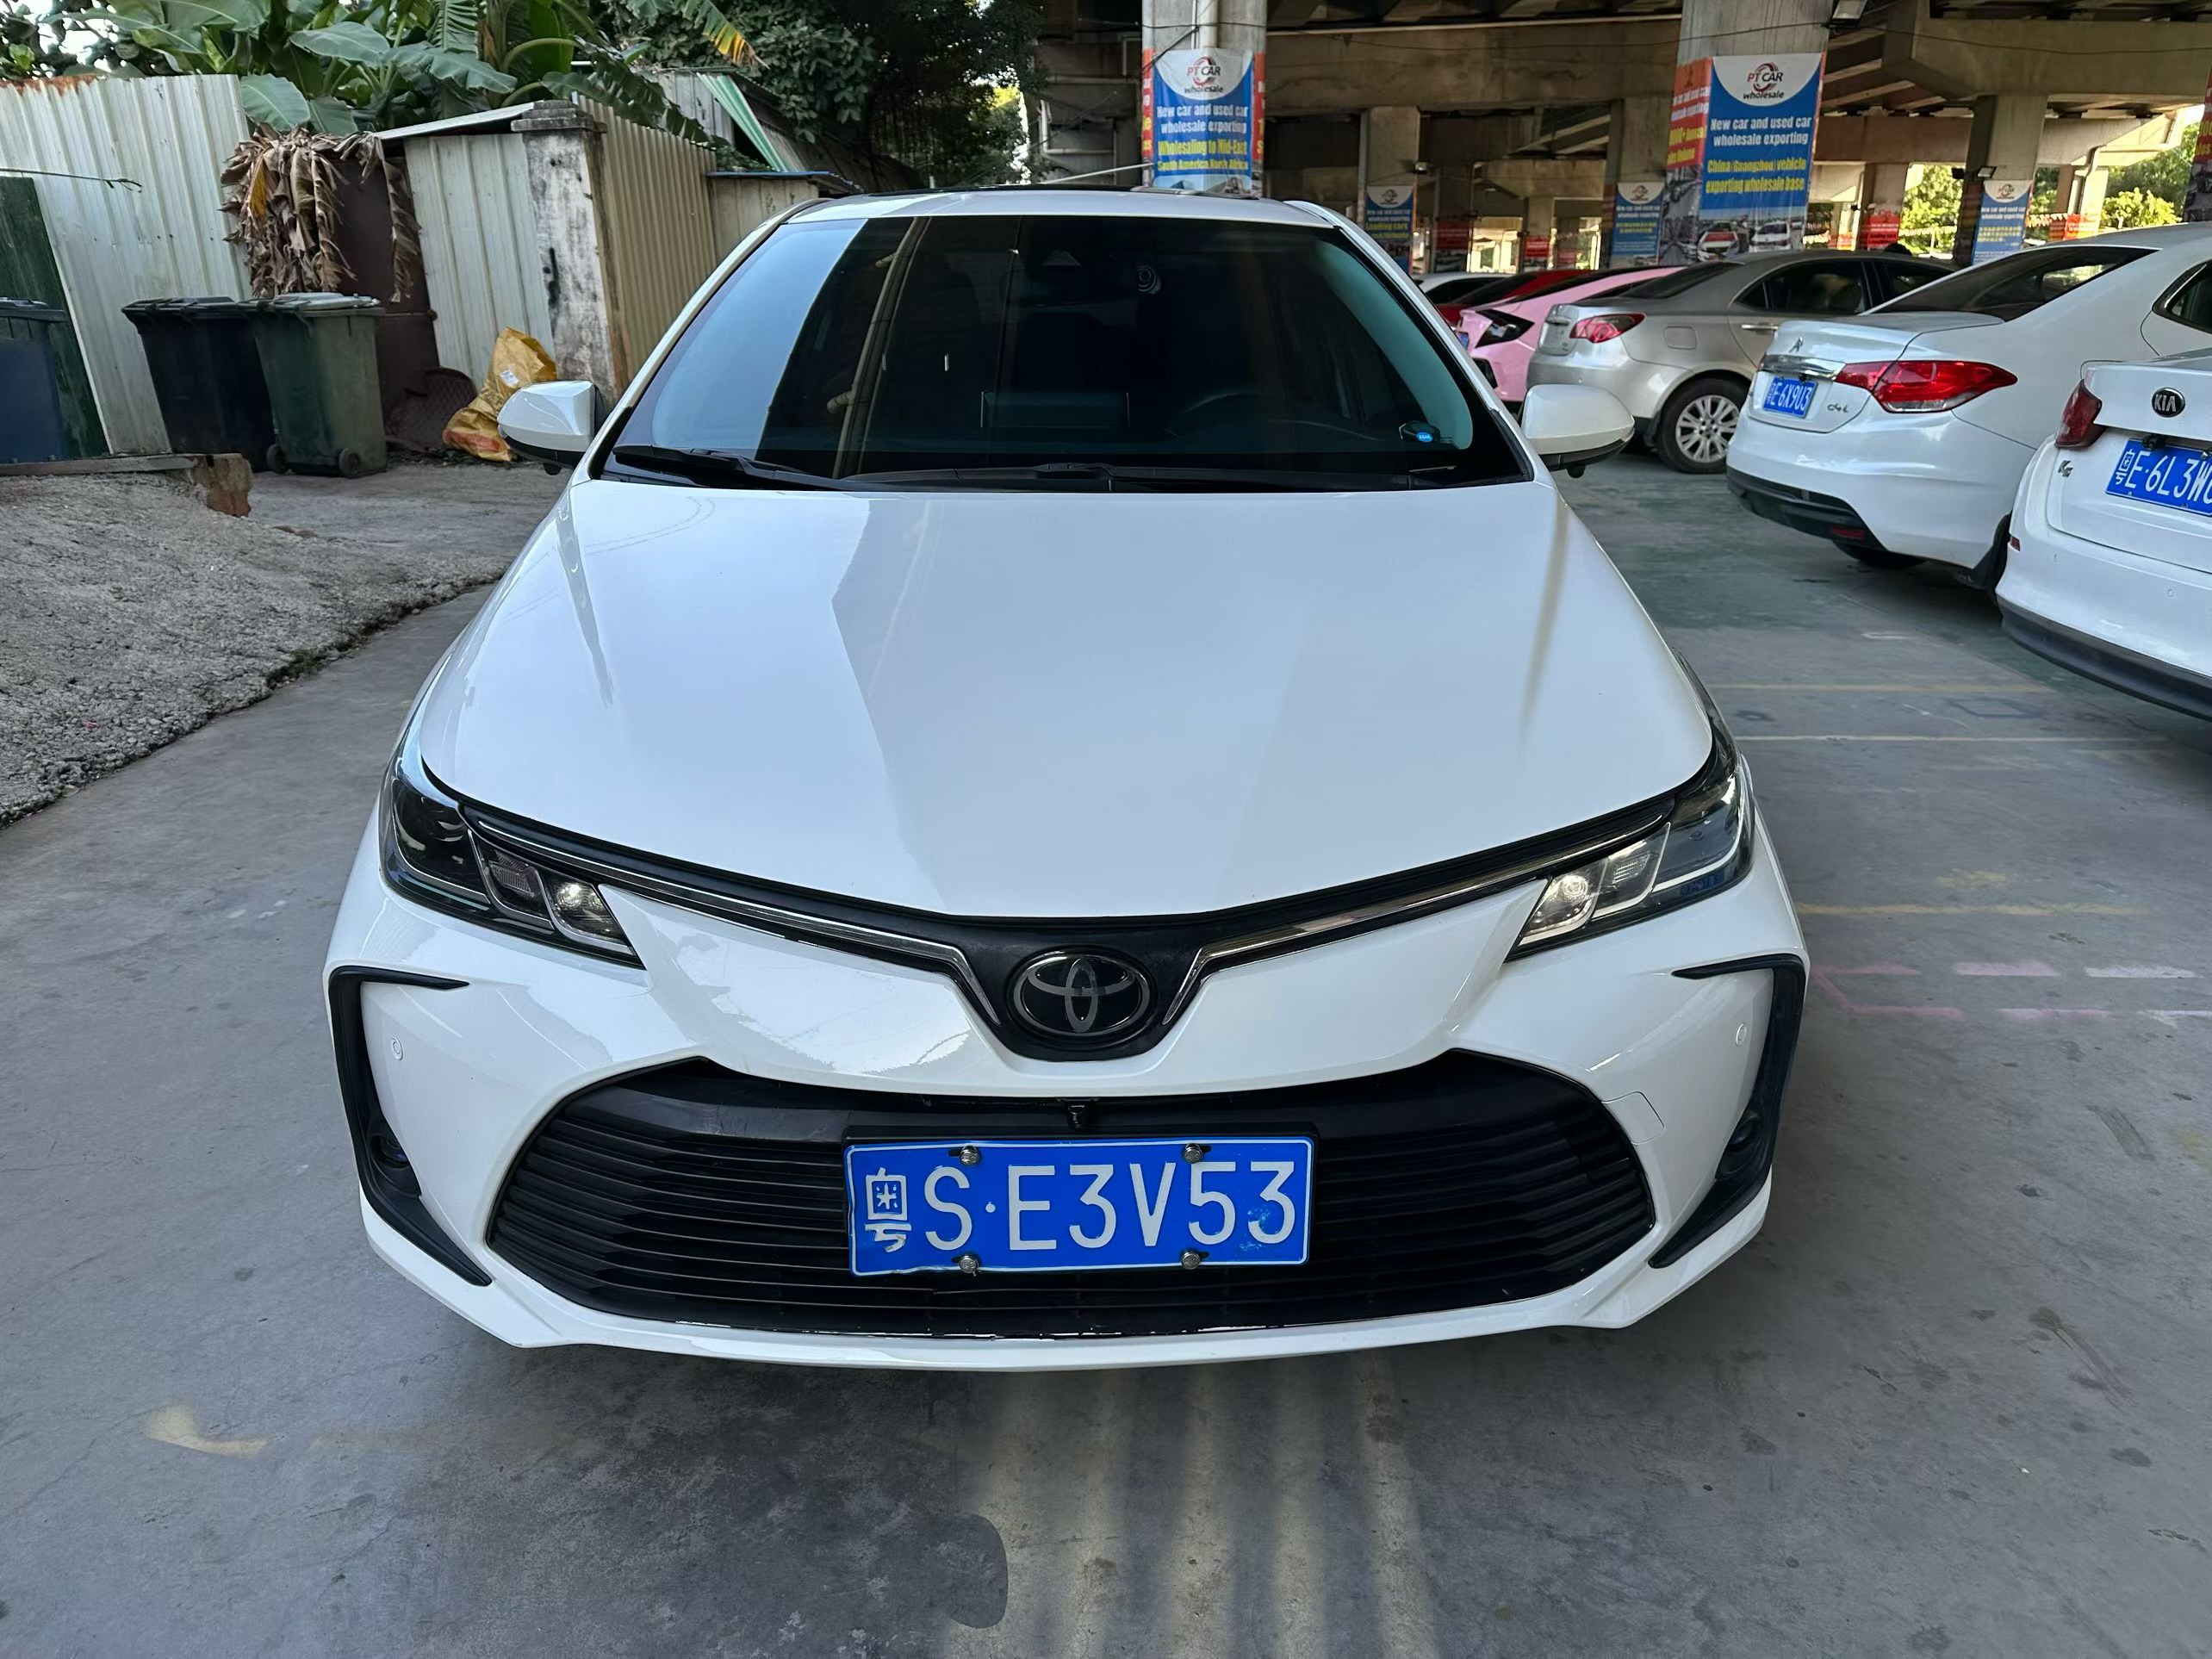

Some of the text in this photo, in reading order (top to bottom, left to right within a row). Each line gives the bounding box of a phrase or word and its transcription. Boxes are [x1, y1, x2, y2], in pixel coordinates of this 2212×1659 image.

[1187, 66, 1221, 76] PT CAR
[1747, 71, 1783, 82] PT CAR
[1184, 85, 1224, 94] wholesale
[1743, 90, 1785, 99] wholesale
[1157, 103, 1248, 117] New car and used car
[1160, 120, 1247, 134] wholesale exporting
[1710, 116, 1812, 130] New car and used car
[1713, 134, 1762, 146] wholesale
[1763, 132, 1809, 146] exporting
[1209, 140, 1216, 154] to
[1707, 159, 1730, 172] China
[1777, 158, 1806, 171] vehicle
[1706, 176, 1805, 194] exporting wholesale base
[2154, 394, 2177, 413] KIA
[865, 1161, 1296, 1253] 粤S·E3V53
